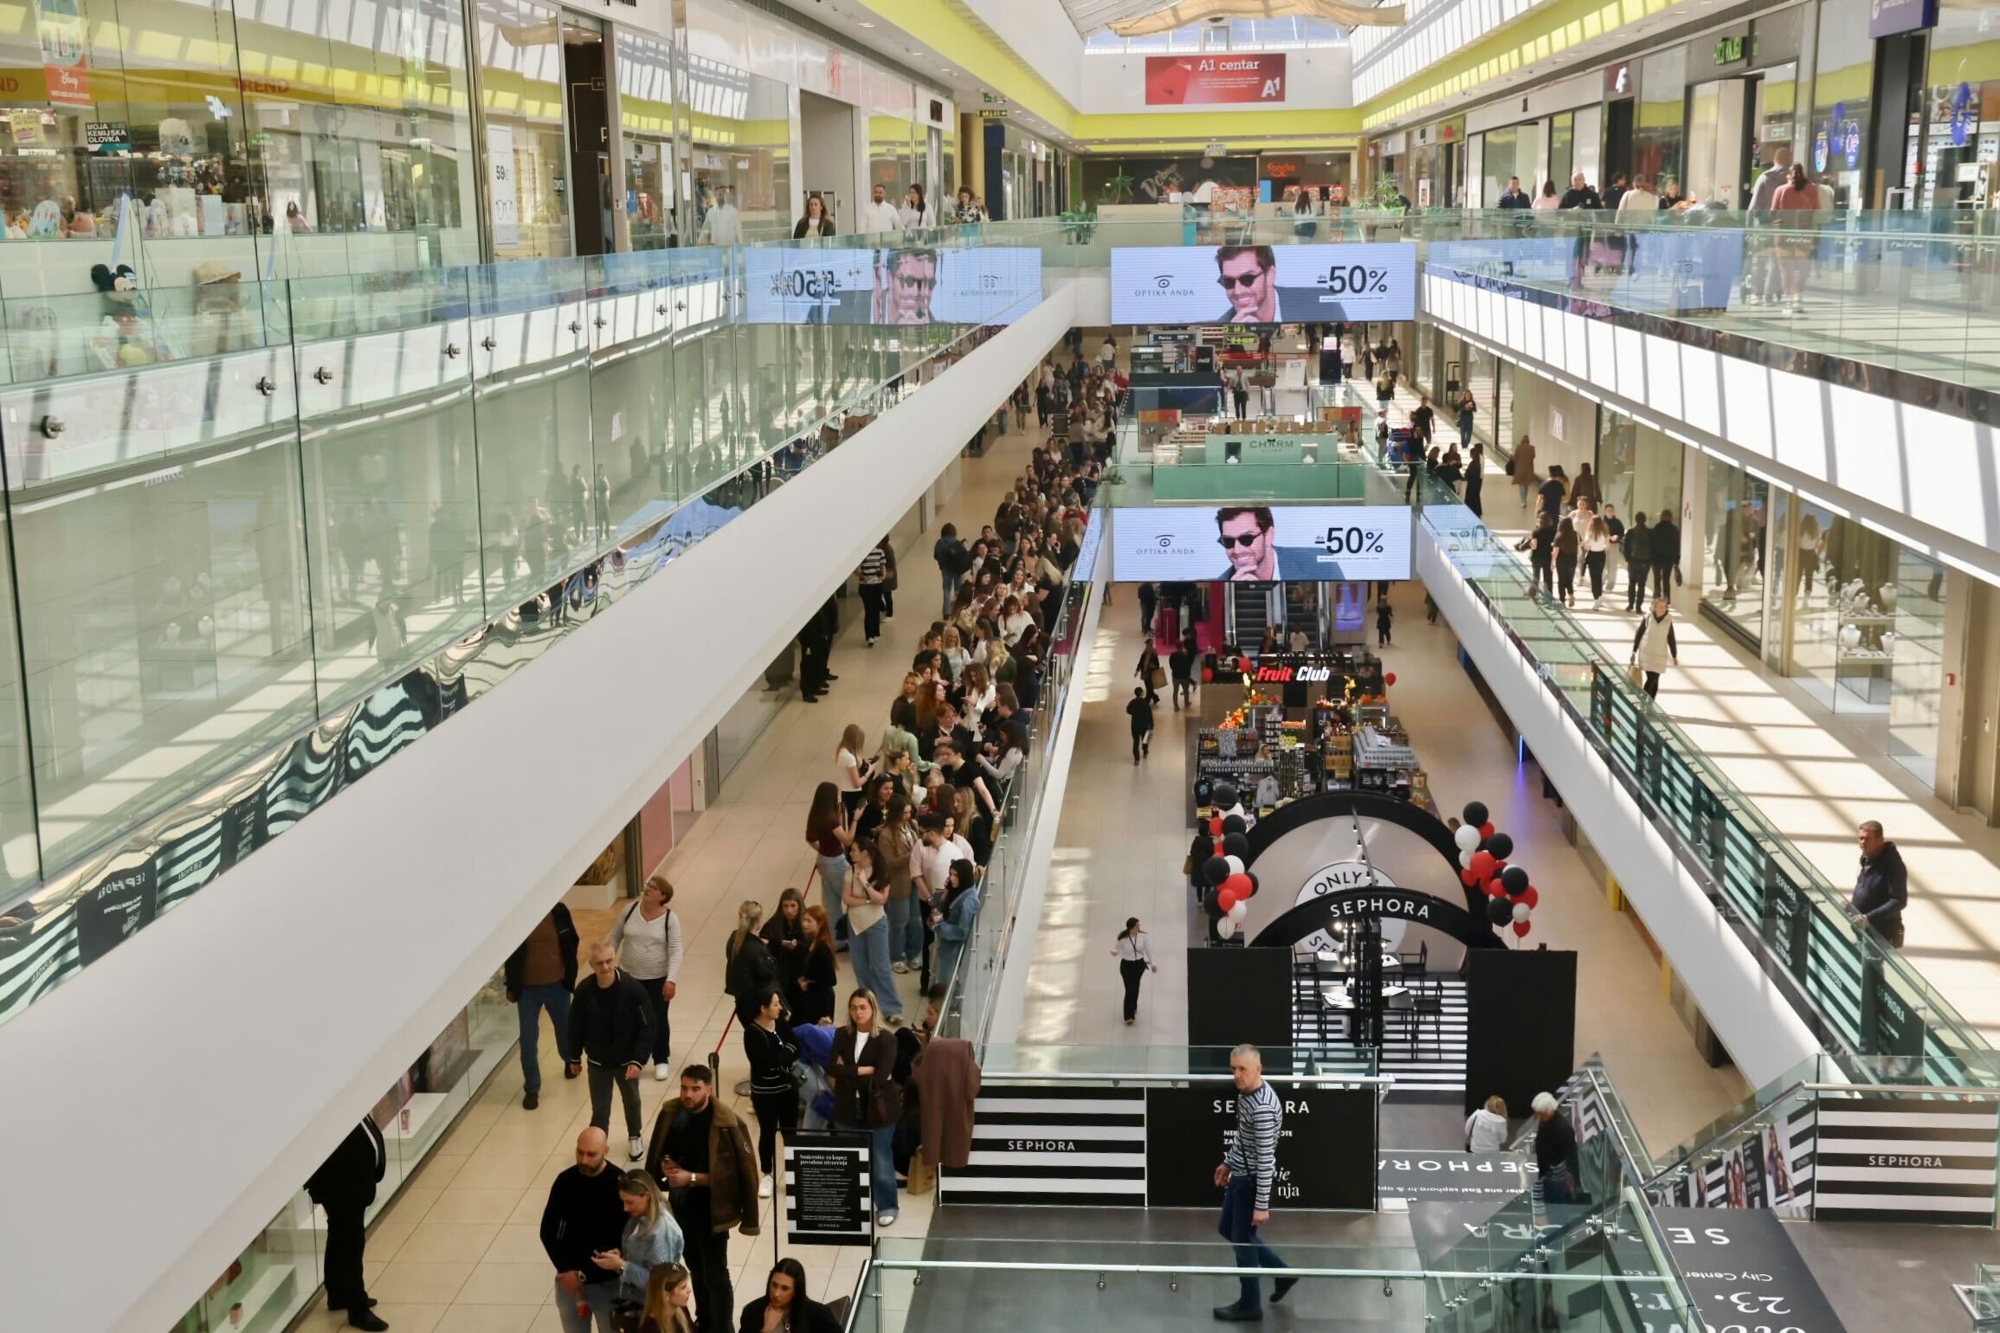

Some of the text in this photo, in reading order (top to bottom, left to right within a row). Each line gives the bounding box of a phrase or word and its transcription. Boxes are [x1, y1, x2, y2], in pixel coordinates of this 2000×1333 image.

[1199, 59, 1260, 71] A1 centar
[231, 78, 289, 93] TREND
[1261, 77, 1280, 97] A1
[1317, 265, 1387, 294] -50%
[1134, 289, 1194, 297] OPTIKA ANDA
[1250, 440, 1293, 448] CHARM
[1314, 527, 1384, 554] -50%
[1257, 665, 1330, 681] Fruit Club
[1314, 871, 1362, 895] ONLY
[1330, 898, 1429, 918] SEPHORA
[1213, 1100, 1310, 1114] SERA
[1008, 1140, 1076, 1151] SEPHORA
[1868, 1155, 1943, 1167] SEPHORA
[1685, 1271, 1773, 1282] City Center
[1714, 1291, 1791, 1315] 23.
